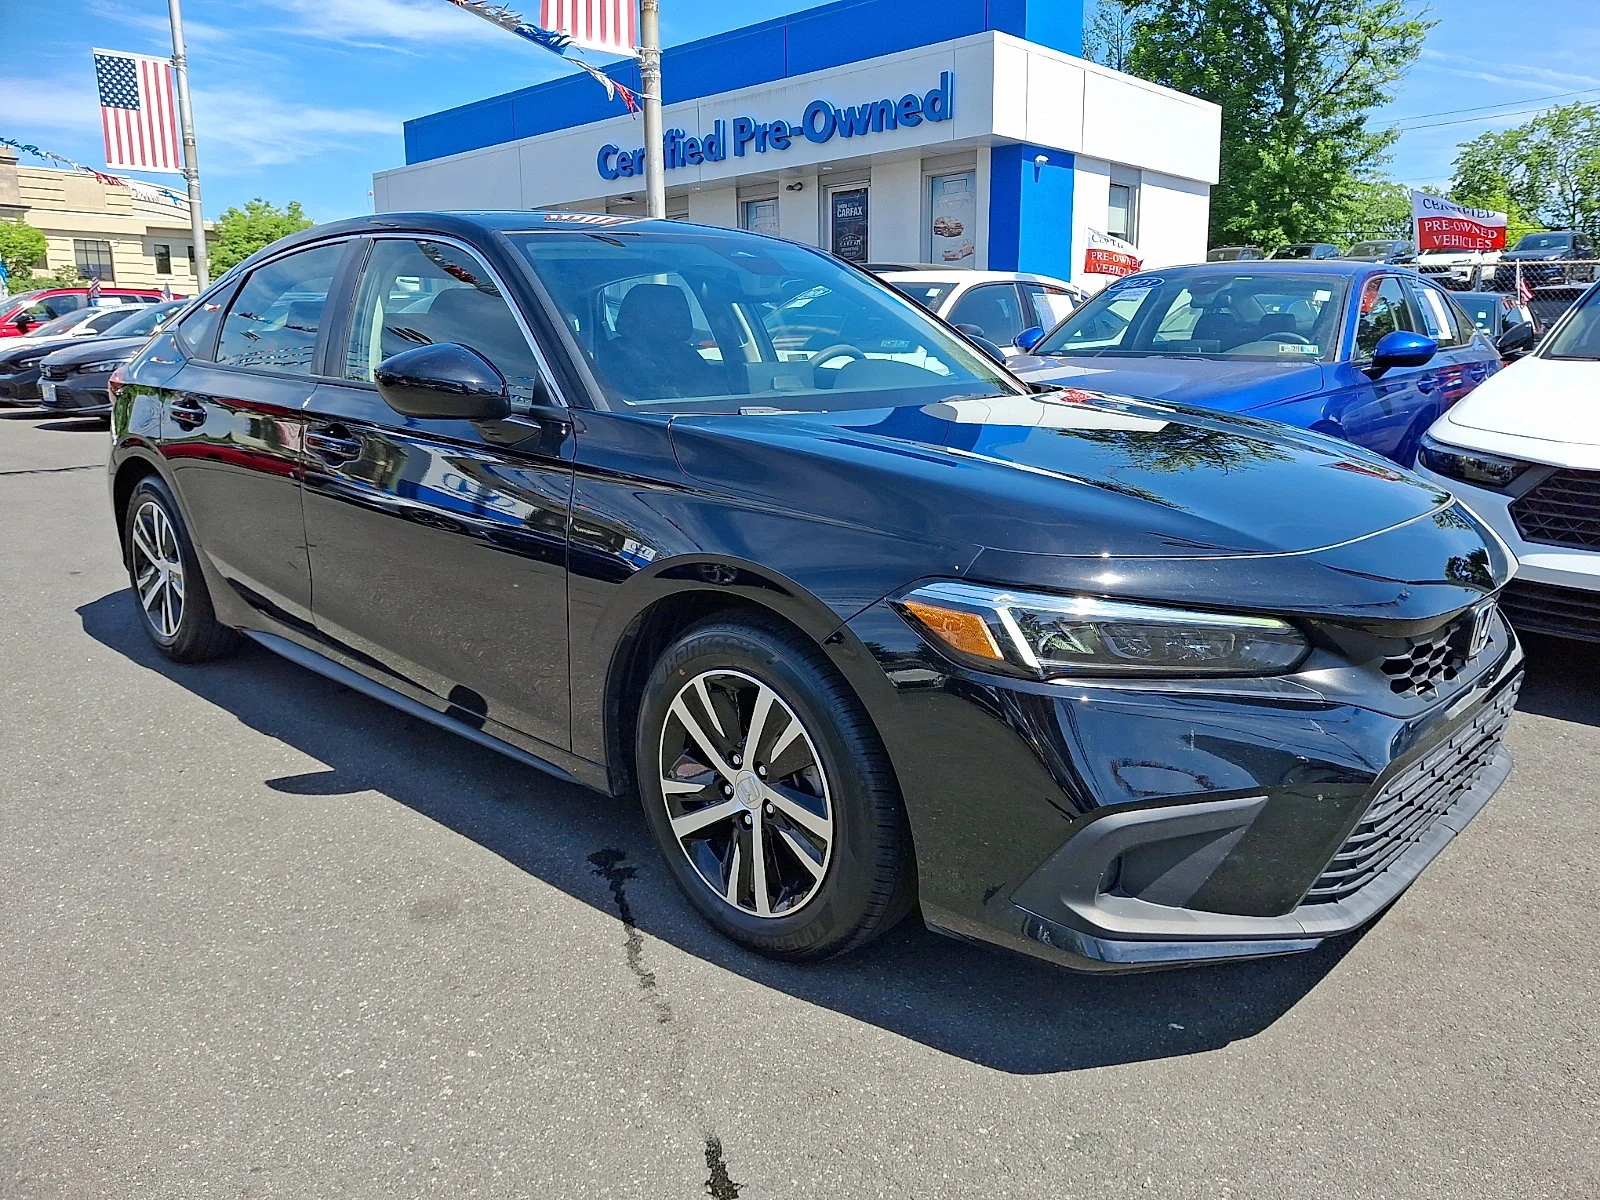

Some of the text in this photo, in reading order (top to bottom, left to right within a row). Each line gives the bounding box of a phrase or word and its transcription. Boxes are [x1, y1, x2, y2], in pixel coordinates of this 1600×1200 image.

[597, 71, 953, 180] Cerfied Pre-Owned
[837, 206, 863, 218] CARFAX
[1424, 220, 1497, 239] PRE-OWNED
[1433, 234, 1492, 249] VEHICLES
